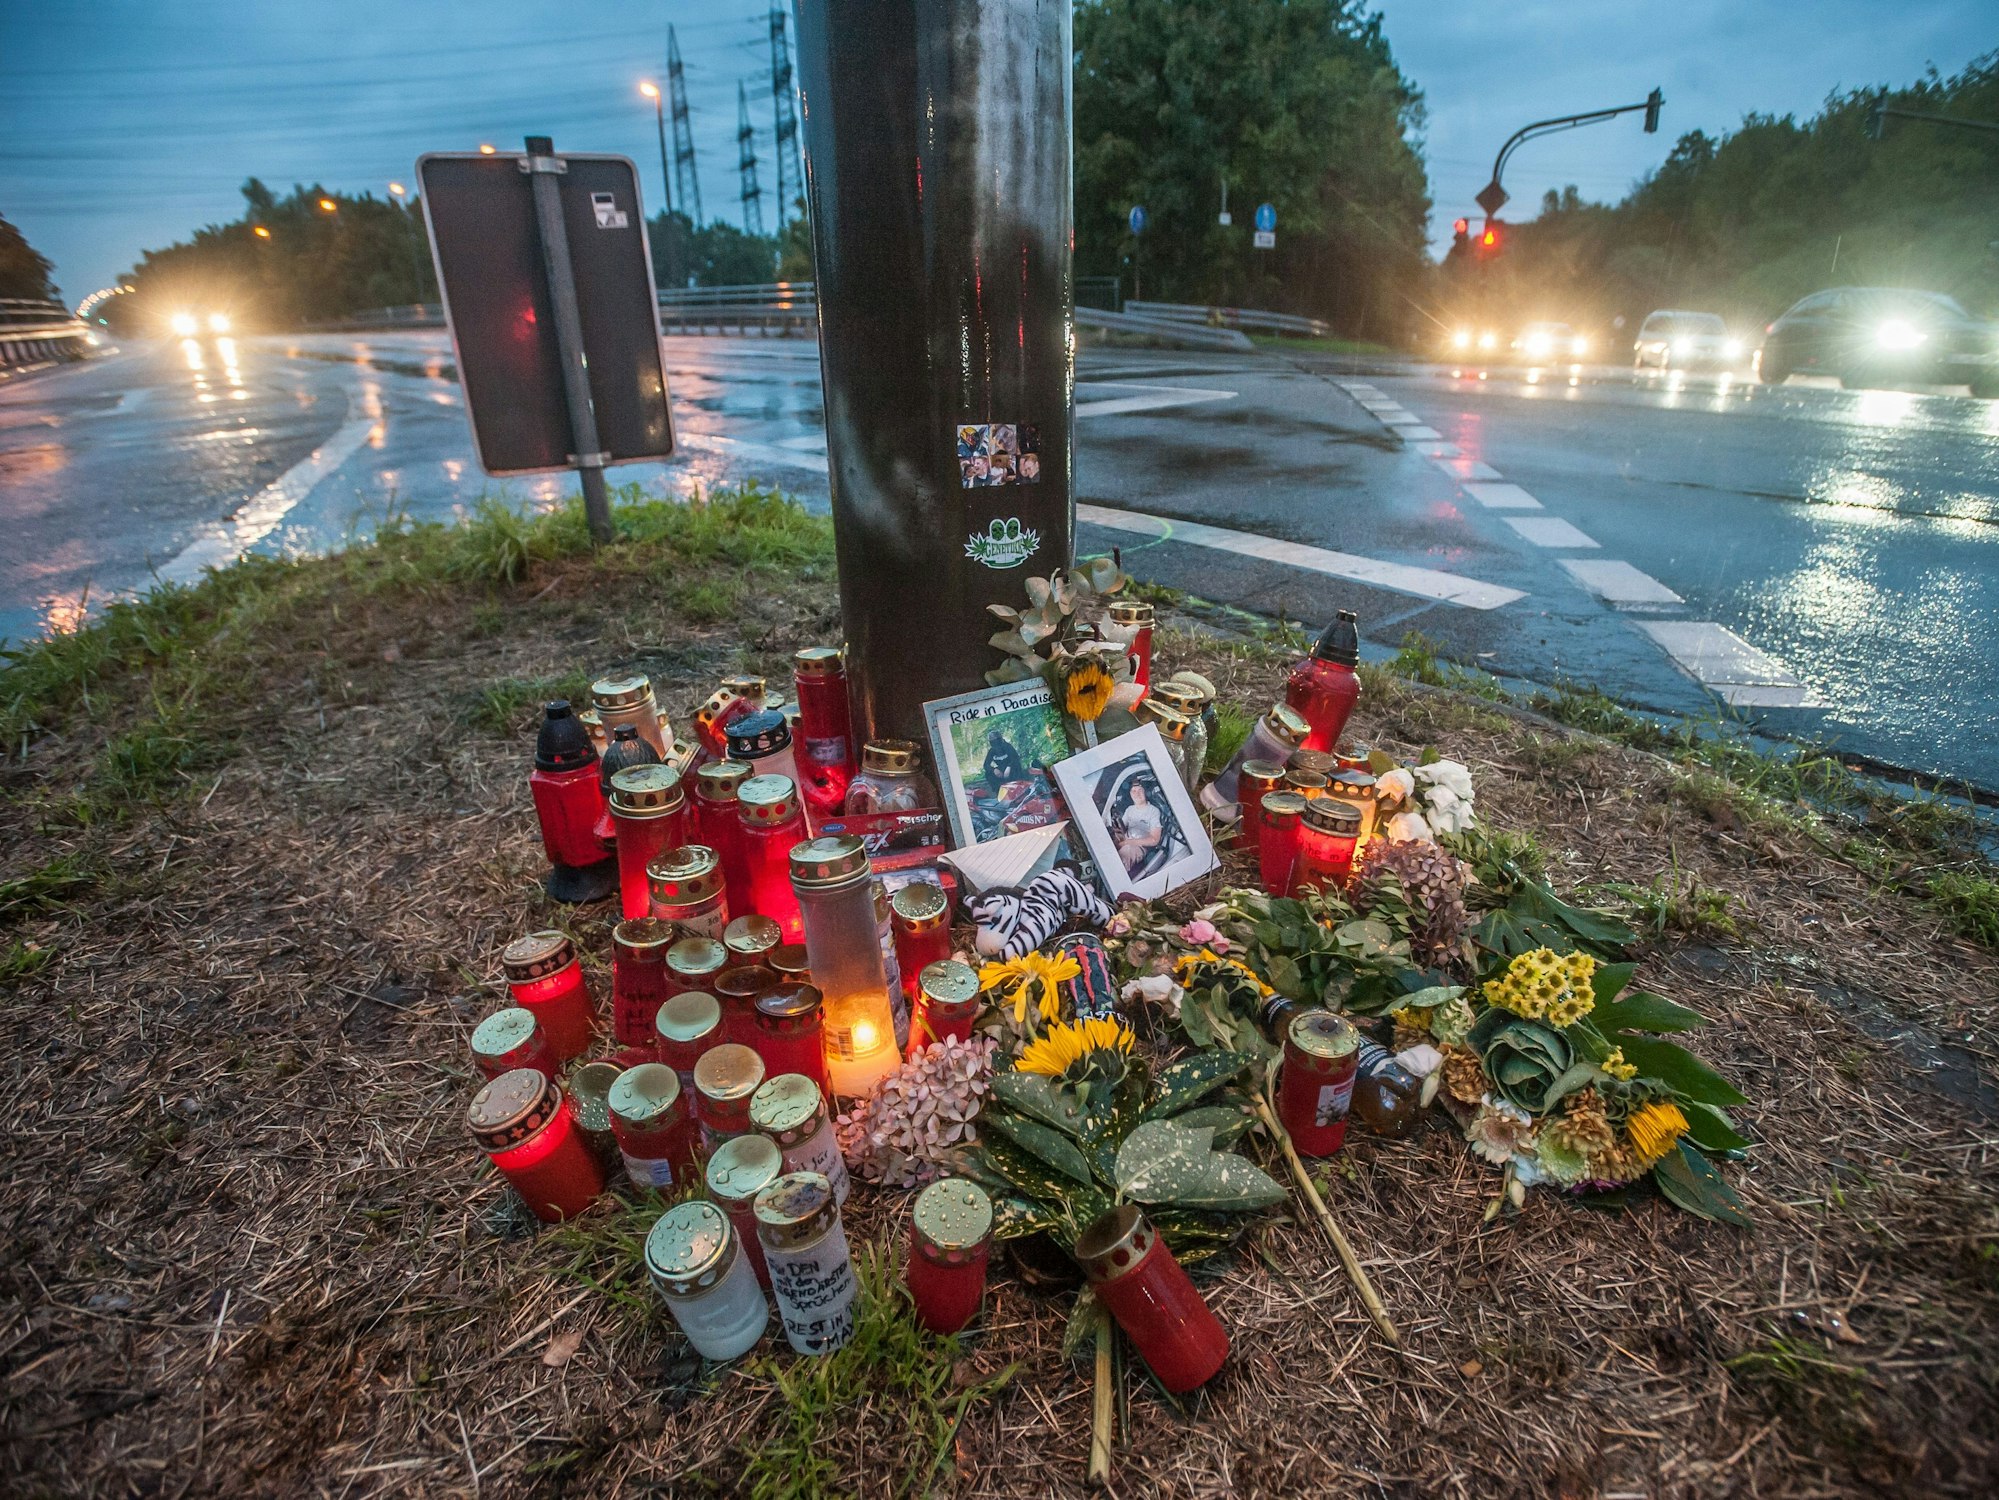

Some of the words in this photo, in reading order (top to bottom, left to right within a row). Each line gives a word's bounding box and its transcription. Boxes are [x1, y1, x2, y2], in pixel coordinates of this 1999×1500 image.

[950, 708, 980, 724] Ride
[984, 705, 996, 716] in
[785, 1318, 827, 1336] REST
[830, 1313, 843, 1330] IN
